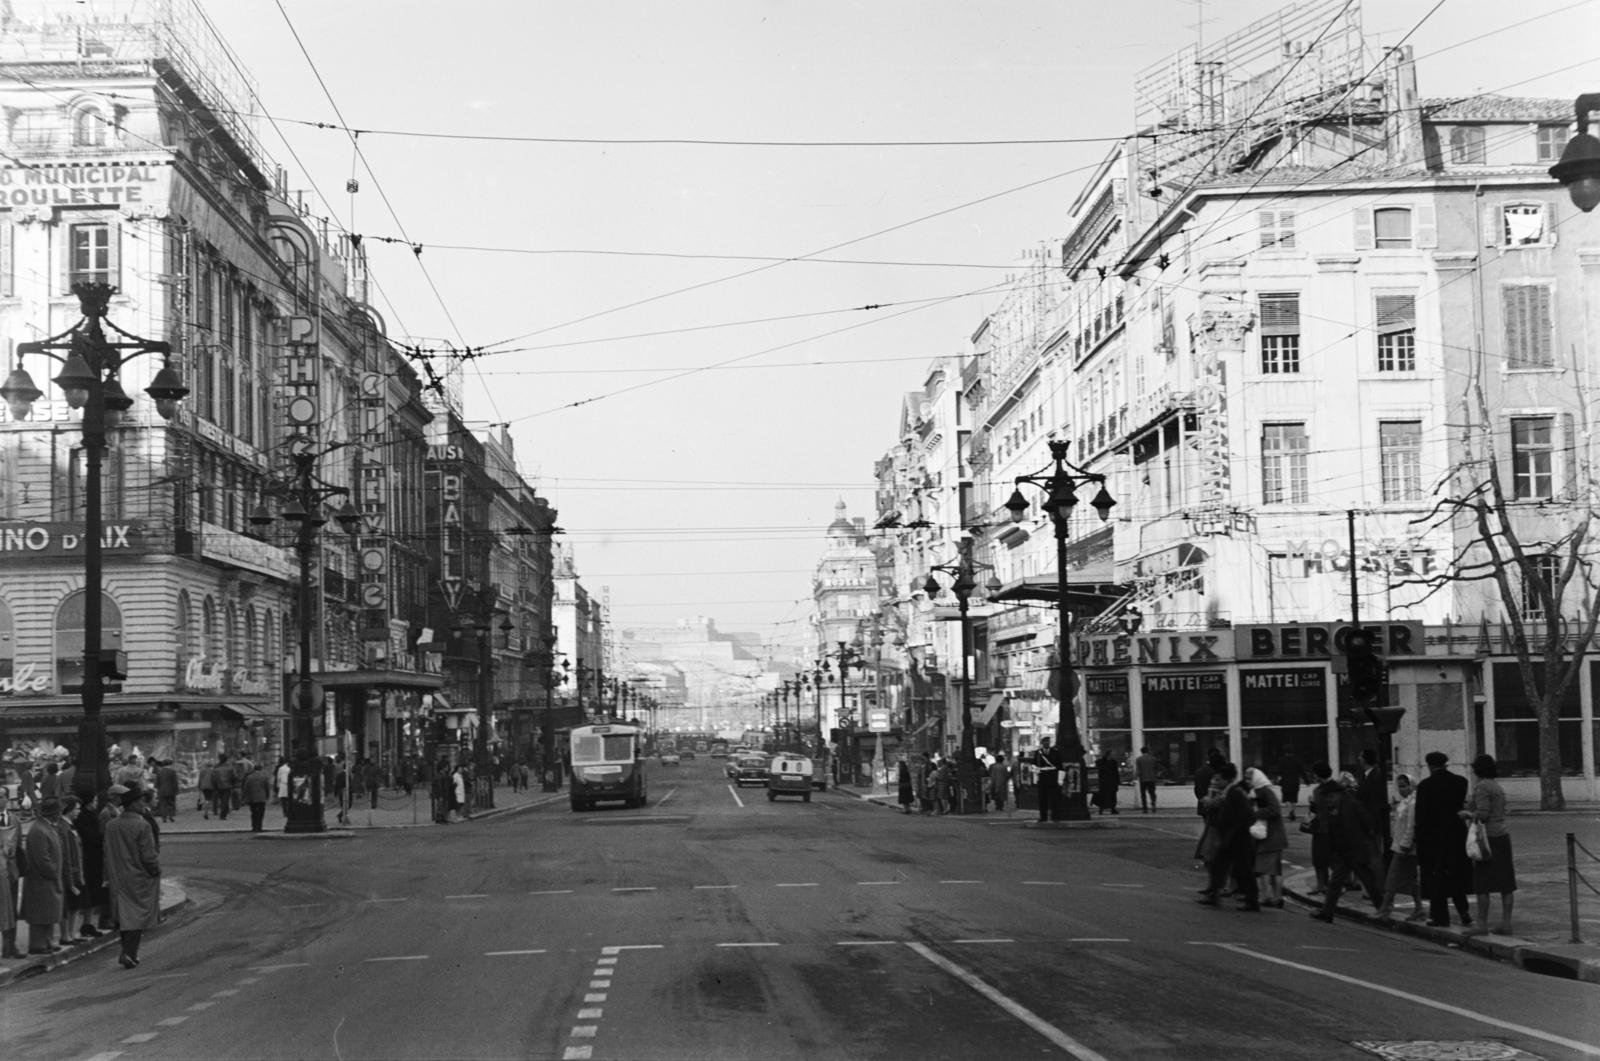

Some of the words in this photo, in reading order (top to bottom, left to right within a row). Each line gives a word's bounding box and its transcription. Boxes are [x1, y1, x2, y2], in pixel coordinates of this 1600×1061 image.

[25, 167, 157, 185] MUNICIPAL
[443, 475, 462, 609] BALLY
[1148, 676, 1200, 691] MATTEI
[1246, 674, 1299, 688] MATTEI
